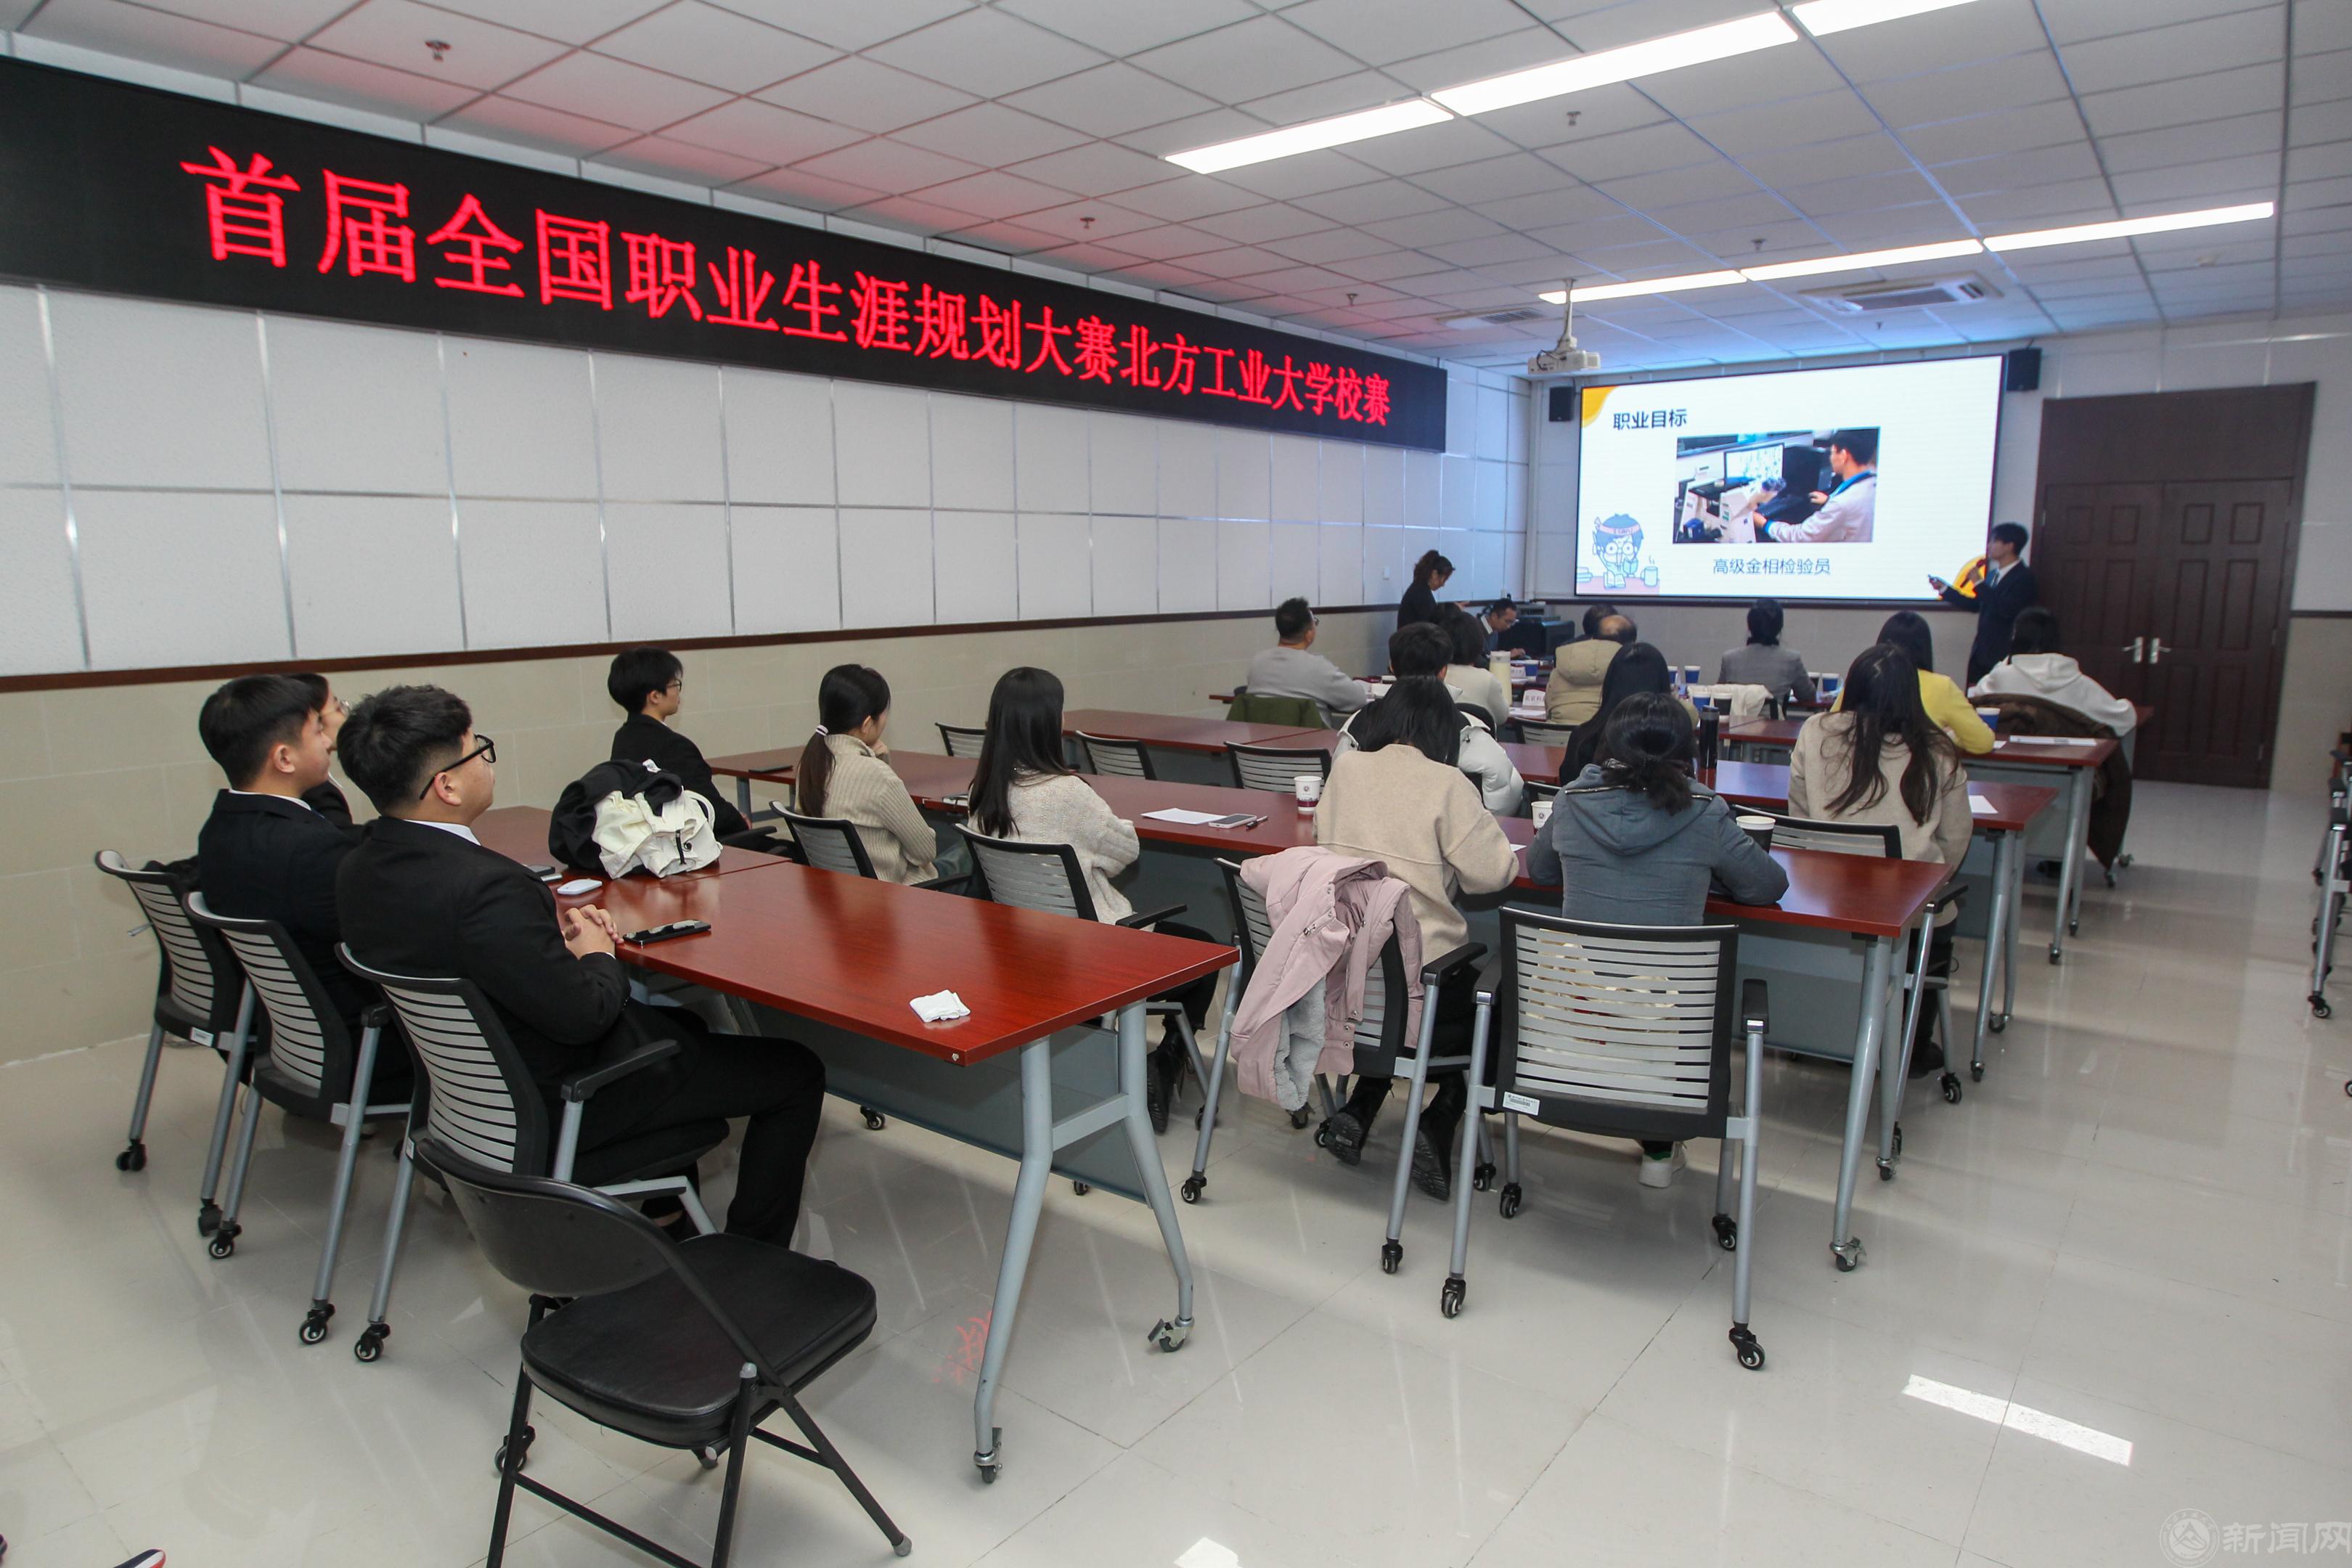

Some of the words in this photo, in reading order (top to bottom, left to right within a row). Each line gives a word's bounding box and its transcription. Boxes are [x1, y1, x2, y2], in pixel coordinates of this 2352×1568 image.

[180, 146, 1390, 425] 首届全国职业生涯规划大赛北方工业大学校赛
[1613, 409, 1687, 430] 职业目标
[1713, 558, 1830, 575] 高级金相检验员
